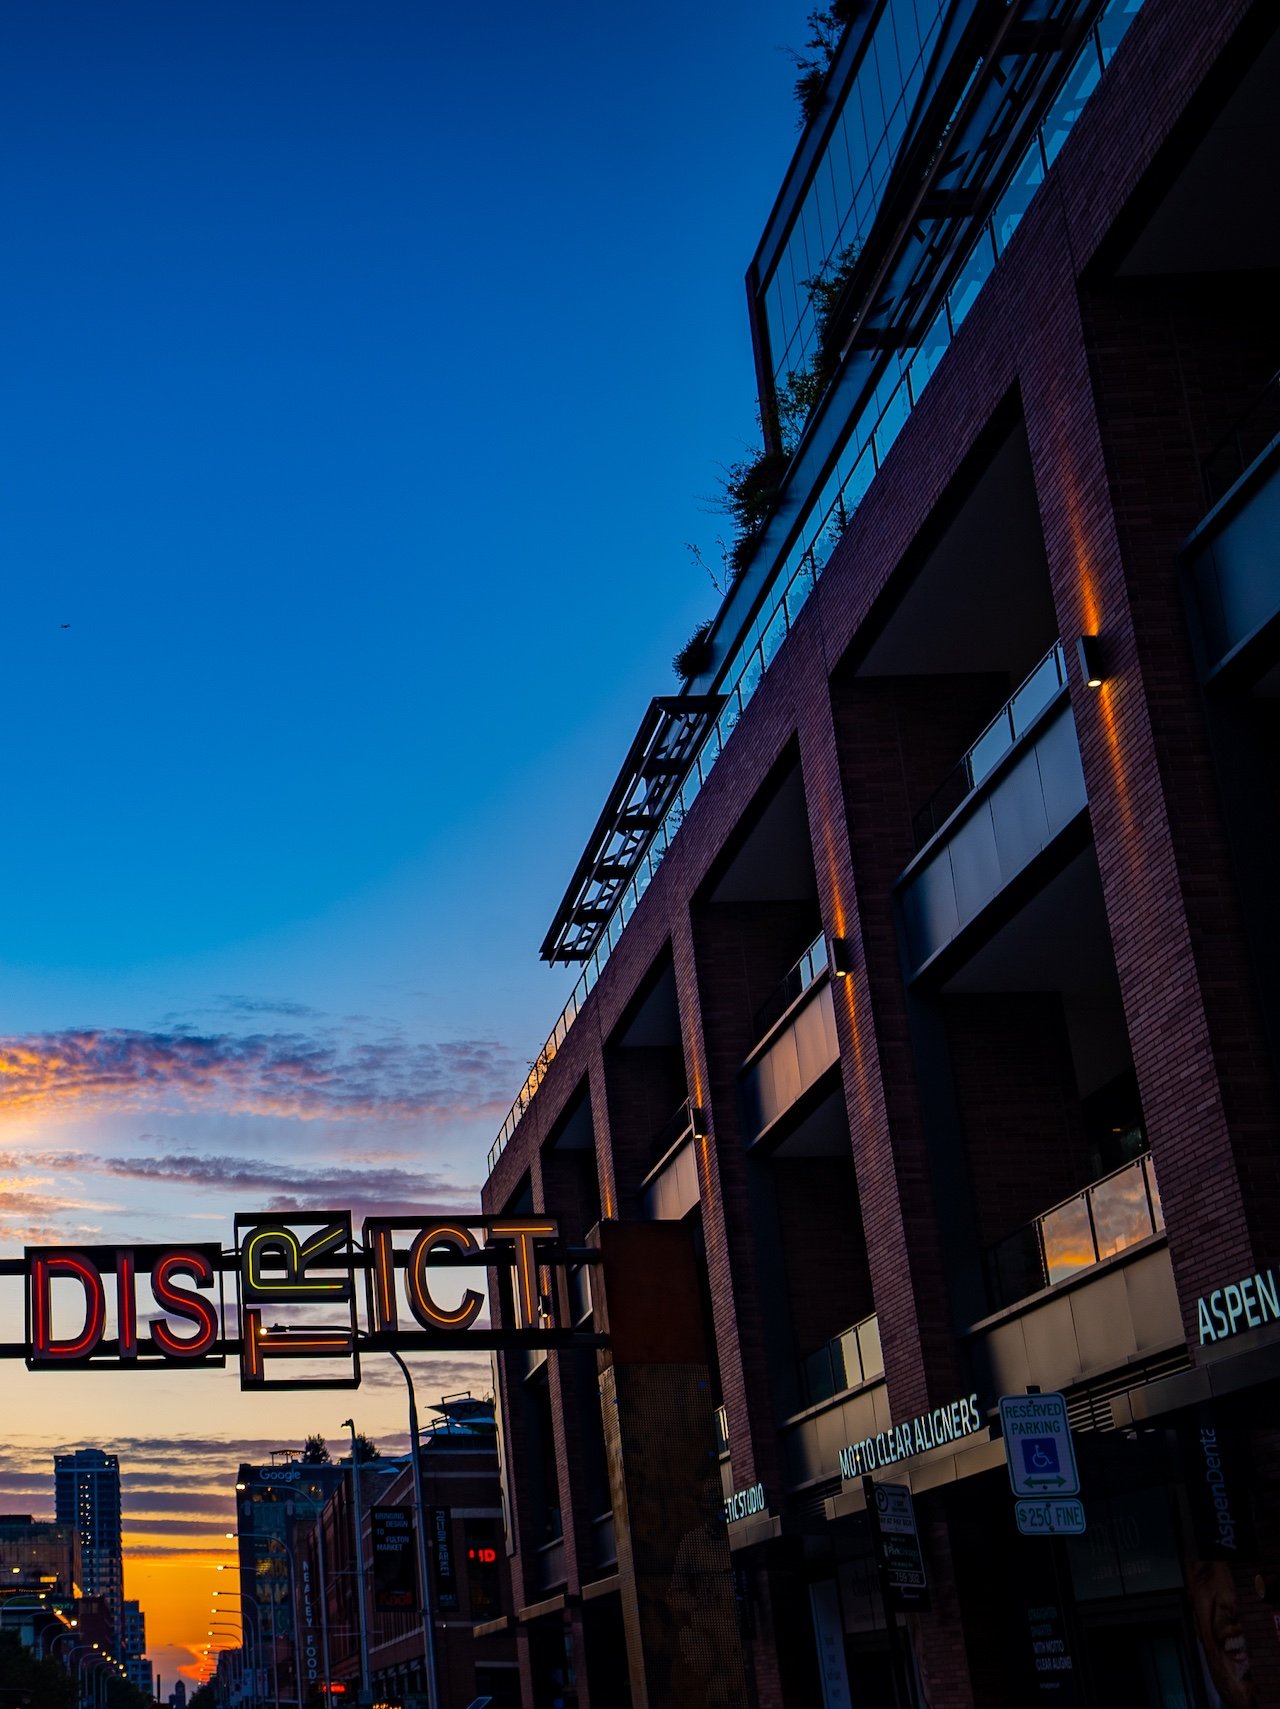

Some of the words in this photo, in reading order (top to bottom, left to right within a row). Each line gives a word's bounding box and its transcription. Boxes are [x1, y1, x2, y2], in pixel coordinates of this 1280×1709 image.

[1197, 1268, 1280, 1346] ASPEN
[1005, 1402, 1062, 1419] RESERVED
[839, 1437, 876, 1480] MOTTO
[875, 1421, 915, 1466] CLEAR
[913, 1393, 981, 1454] ALIGNERS
[1011, 1420, 1061, 1435] PARKING
[259, 1467, 301, 1483] Google
[435, 1510, 447, 1542] FULTON
[1055, 1506, 1083, 1527] FINE
[376, 1528, 385, 1536] TO
[386, 1535, 410, 1543] FULTON
[376, 1543, 403, 1552] MARKET
[438, 1544, 451, 1577] MARKET
[302, 1560, 313, 1628] NEALEY
